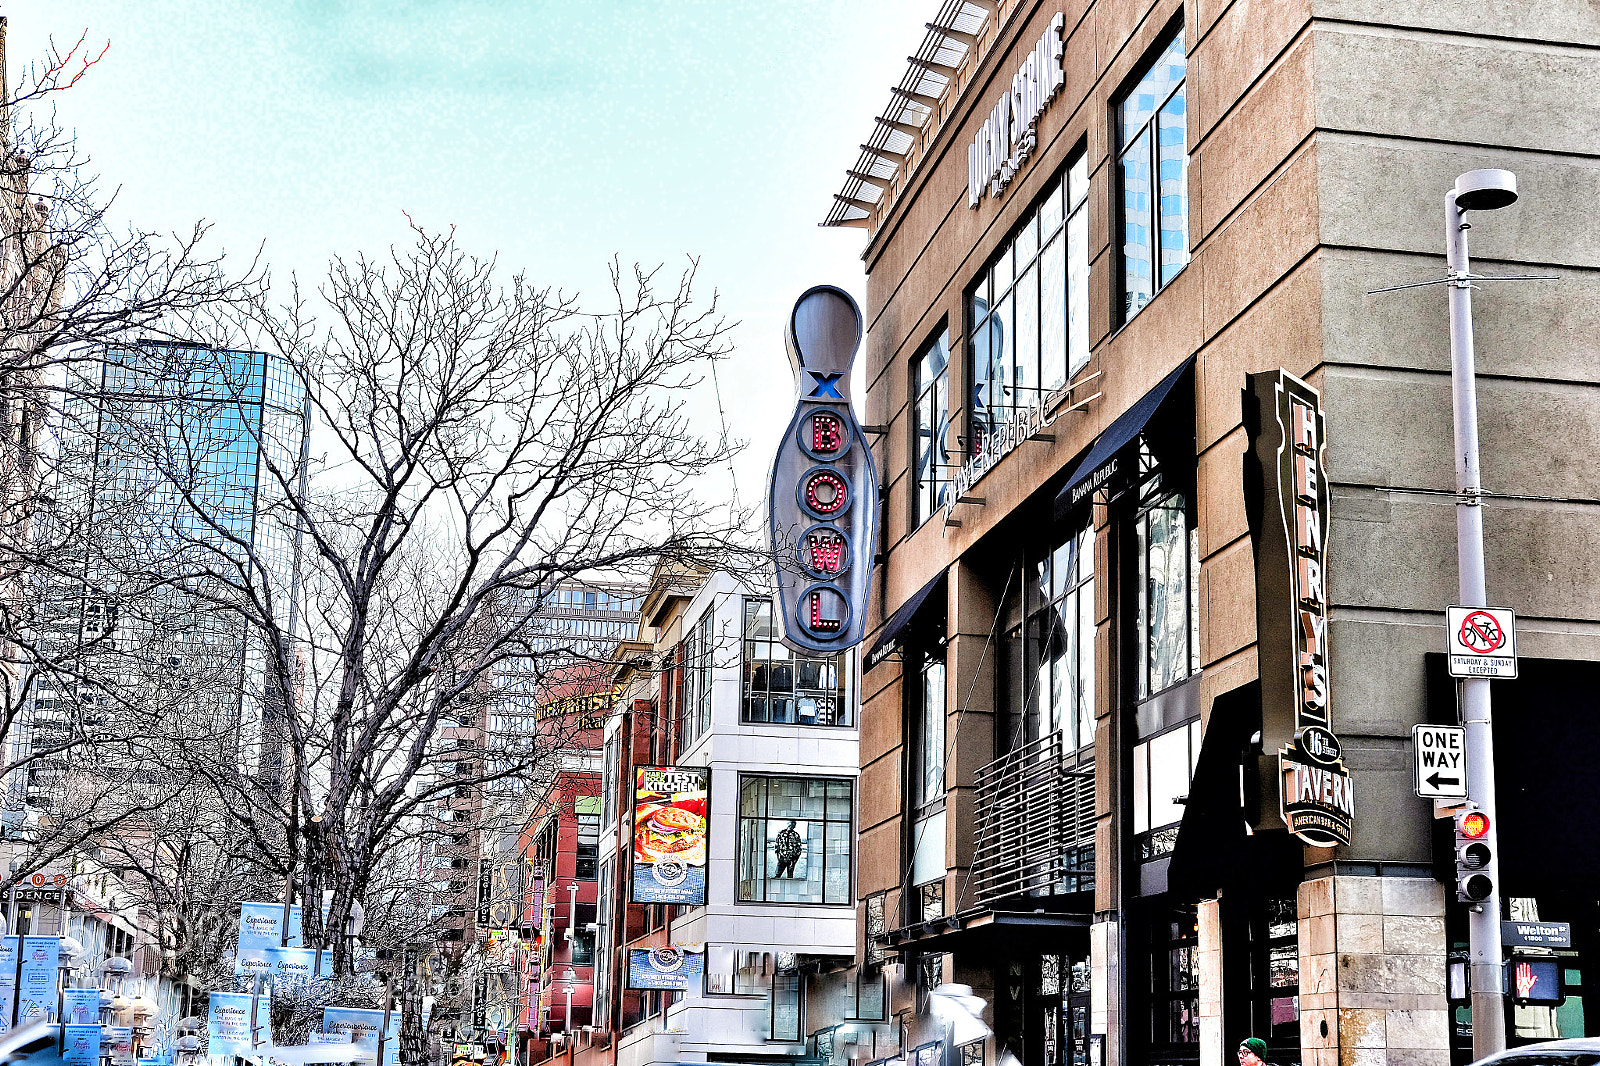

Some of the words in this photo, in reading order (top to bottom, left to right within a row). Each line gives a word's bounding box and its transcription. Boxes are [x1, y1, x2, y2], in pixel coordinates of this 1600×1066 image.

[968, 91, 1011, 210] LUCKY
[1010, 12, 1065, 146] STRIKE
[991, 128, 1037, 199] LANES
[979, 391, 1058, 474] REPUBLIC
[1072, 478, 1093, 504] BANANA
[1093, 458, 1118, 488] REPUBLIC
[1292, 403, 1327, 709] HENRY'S
[1453, 657, 1481, 666] SATURDAY
[1483, 658, 1489, 666] &
[1490, 659, 1512, 667] SUNDAY
[1468, 666, 1498, 675] EXCEPTED
[1423, 731, 1460, 750] ONE
[1423, 751, 1461, 769] WAY
[666, 772, 697, 783] TEST
[645, 782, 698, 792] KITCHEN
[1282, 759, 1355, 819] TAVERN
[1294, 815, 1321, 827] AMERICAN
[1335, 824, 1349, 840] GRILL
[245, 915, 278, 926] Experience
[1517, 925, 1559, 936] Welton
[241, 958, 273, 969] Experience
[277, 960, 309, 971] Experience
[214, 1006, 246, 1017] Experience
